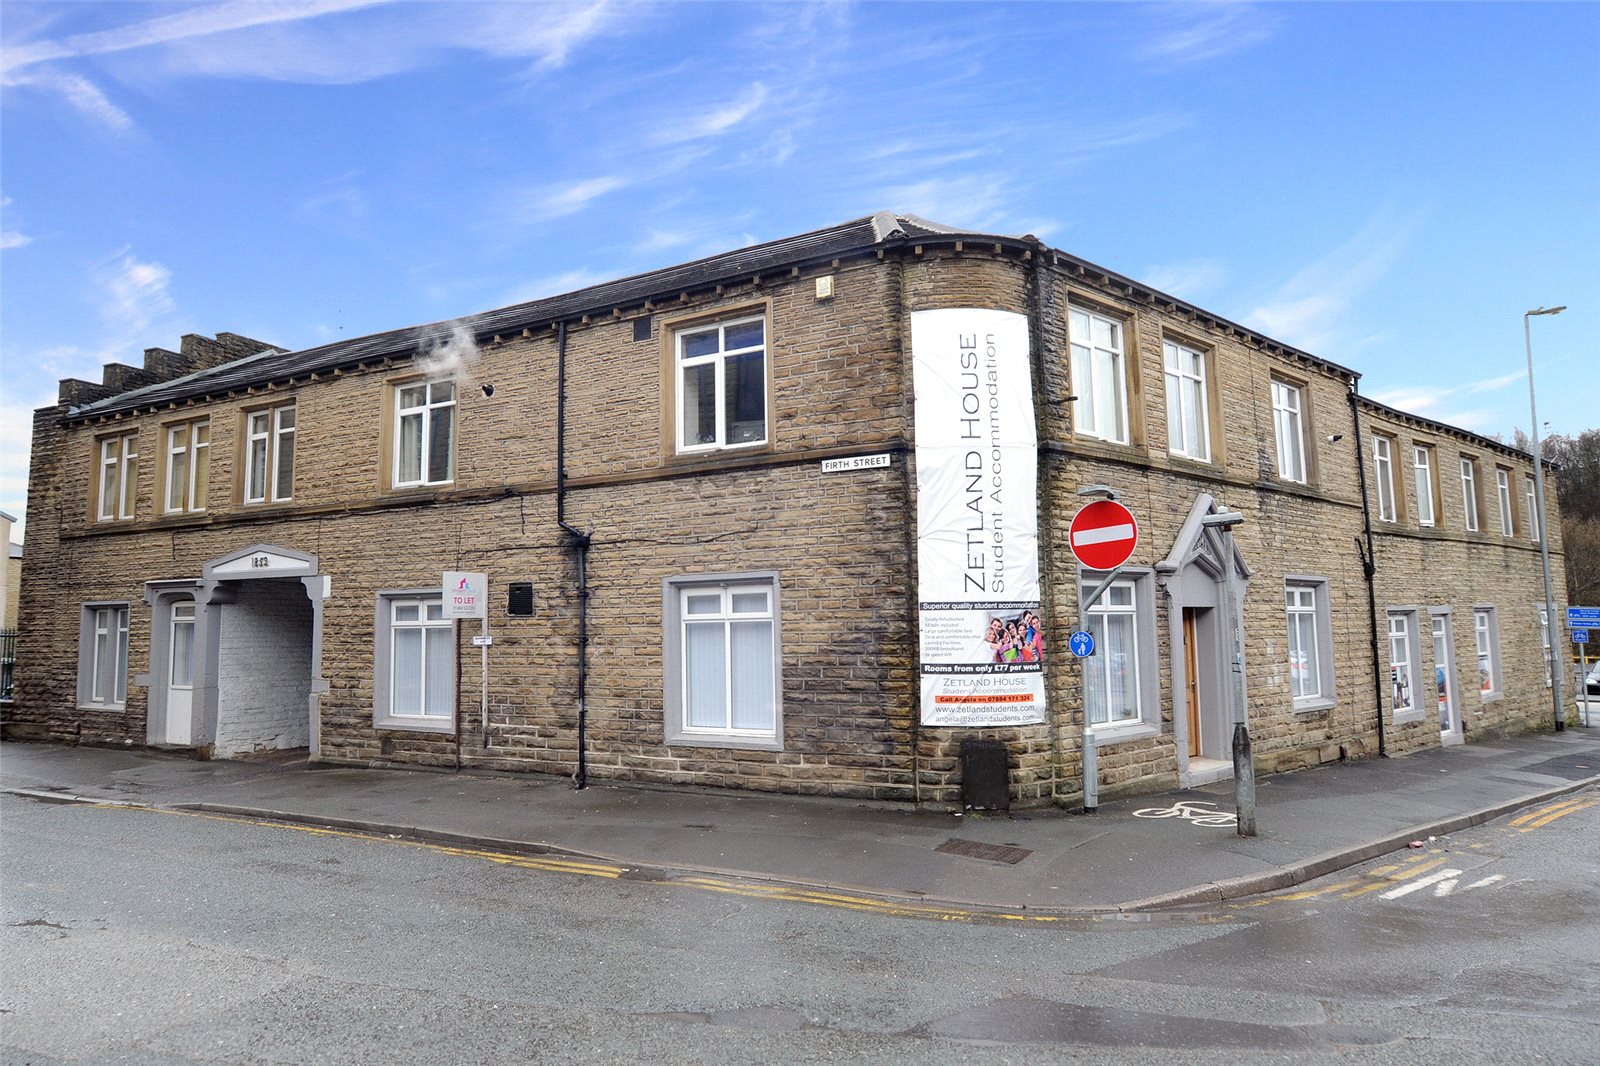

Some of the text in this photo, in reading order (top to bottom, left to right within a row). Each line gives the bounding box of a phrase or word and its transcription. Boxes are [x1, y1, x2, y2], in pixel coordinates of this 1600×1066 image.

[825, 457, 887, 469] FIRTH STREET
[959, 333, 986, 592] ZETLAND HOUSE
[984, 333, 1003, 593] Student Accommodation
[923, 602, 950, 610] Superior
[975, 665, 992, 673] only
[943, 678, 990, 686] ZETLAND
[936, 705, 1034, 713] www.zetlandstudents.com
[936, 714, 1034, 724] angela@zetlandstudents.com
